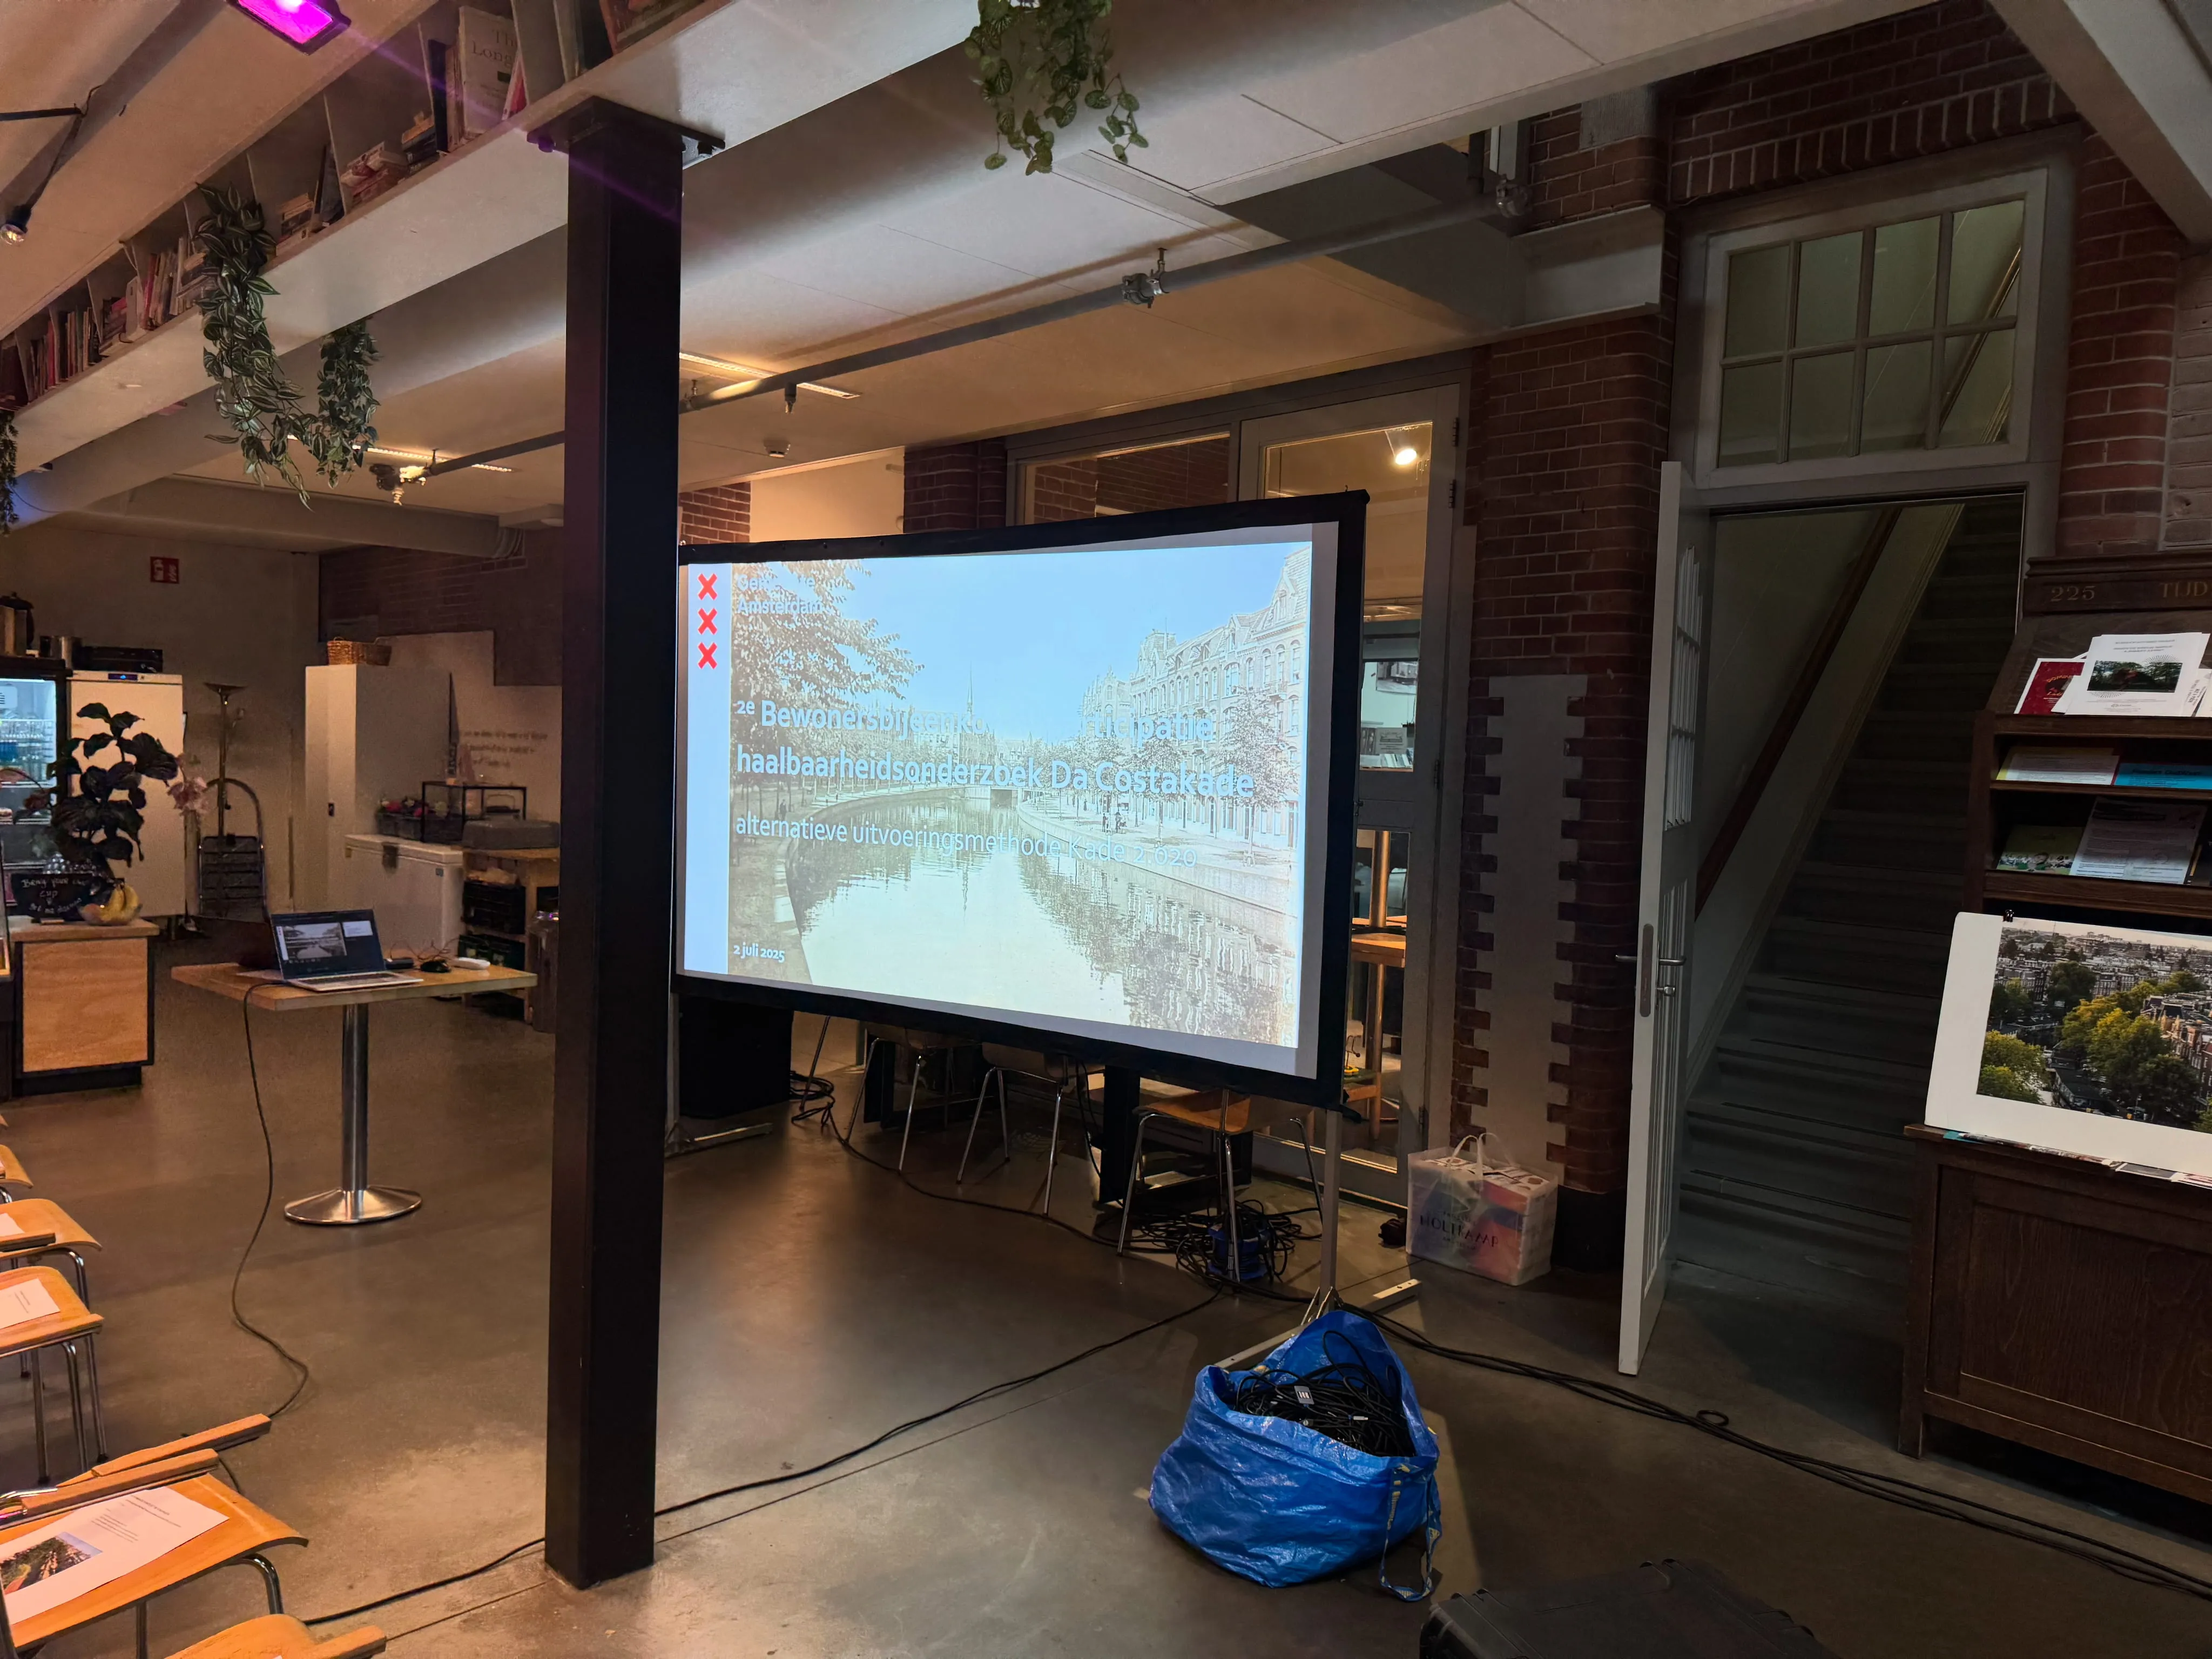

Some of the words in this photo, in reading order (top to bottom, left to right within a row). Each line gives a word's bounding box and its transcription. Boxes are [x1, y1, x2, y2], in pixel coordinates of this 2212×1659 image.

[2050, 585, 2096, 602] 225
[2159, 580, 2212, 598] TIJD
[737, 598, 822, 616] Amsterdam
[736, 700, 756, 715] 2e
[761, 699, 989, 740] Bewonersbijeenko
[737, 744, 1043, 788] haalbaarheidsonderzoek
[1051, 760, 1088, 790] Da
[1096, 760, 1255, 798] Costakade
[736, 811, 847, 842] alternatieve
[852, 821, 1061, 860] uitvoeringsmethode
[1068, 831, 1125, 863] Kade
[1135, 845, 1197, 867] 2.020
[733, 945, 740, 955] 2
[740, 941, 759, 959] juli
[760, 948, 785, 963] 2025
